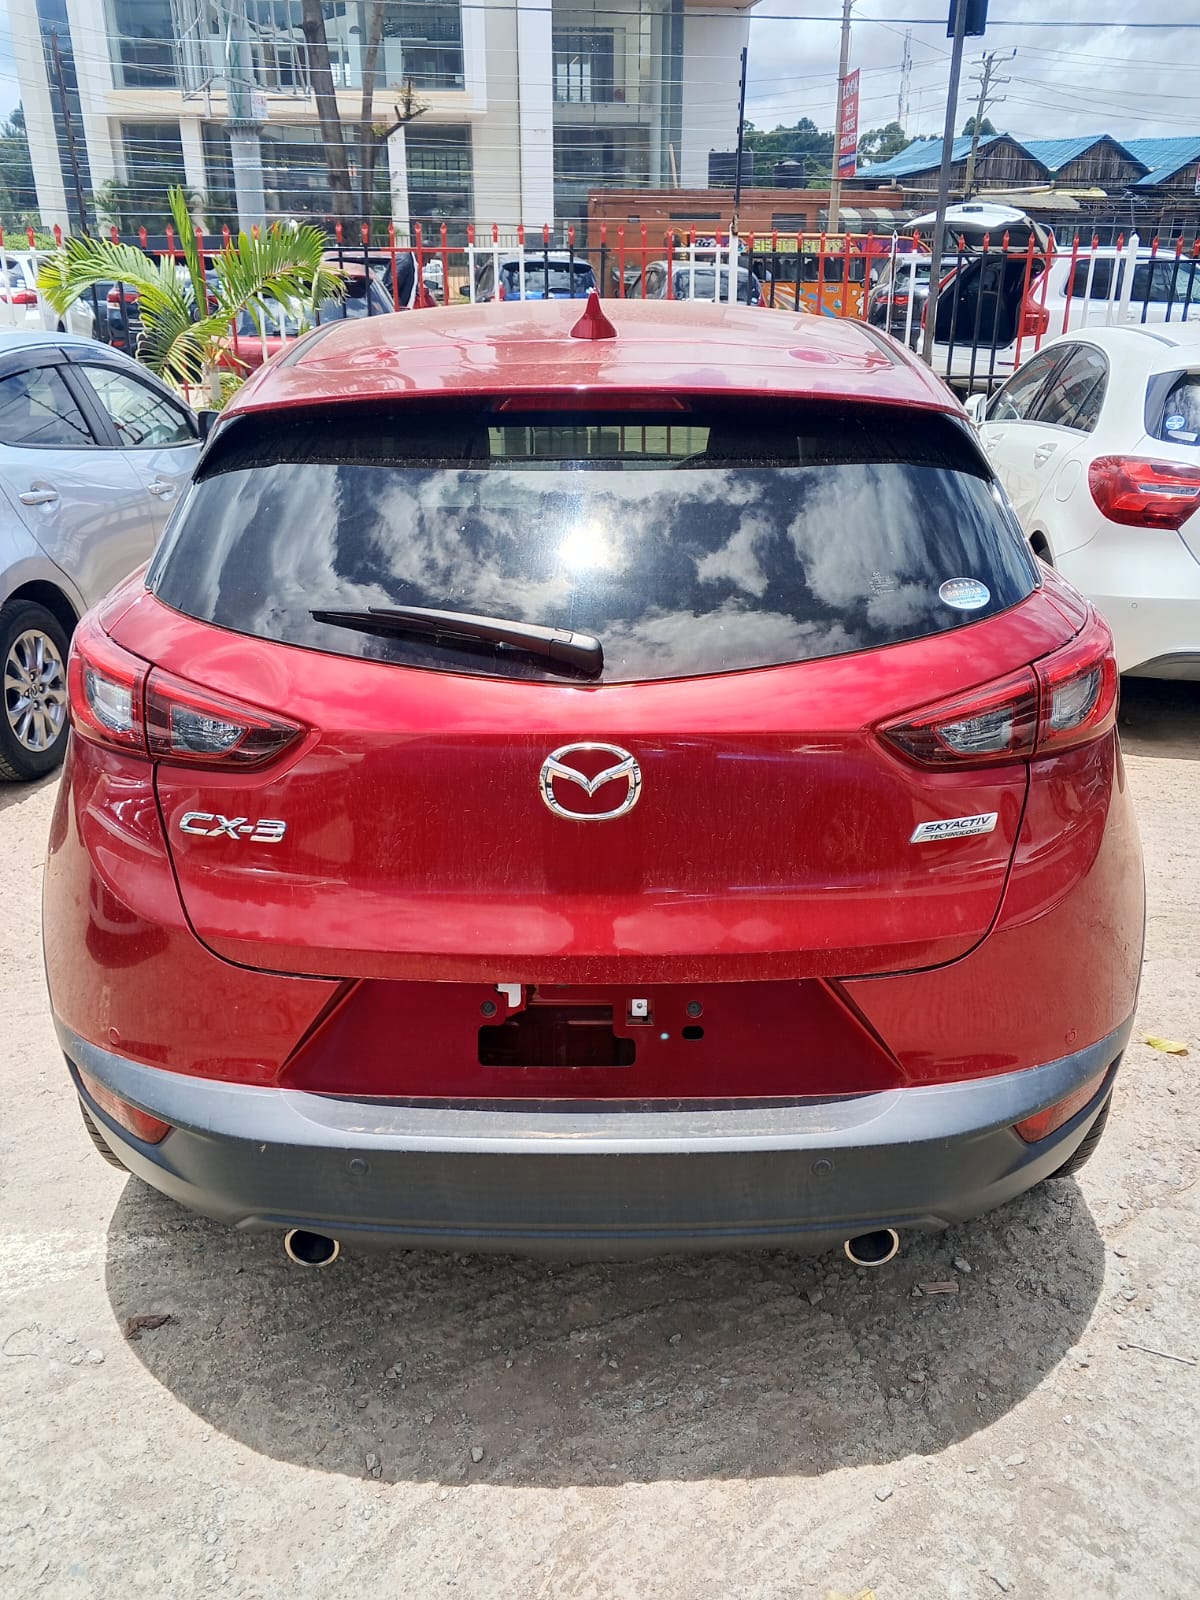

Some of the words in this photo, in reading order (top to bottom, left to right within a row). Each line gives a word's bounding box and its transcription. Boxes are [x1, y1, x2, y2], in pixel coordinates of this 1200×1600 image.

[842, 118, 856, 133] THESE
[840, 135, 857, 150] SPACES
[179, 812, 287, 843] CX-3
[924, 817, 991, 833] SKYACTIV
[929, 828, 983, 840] TECHNOLOGY
